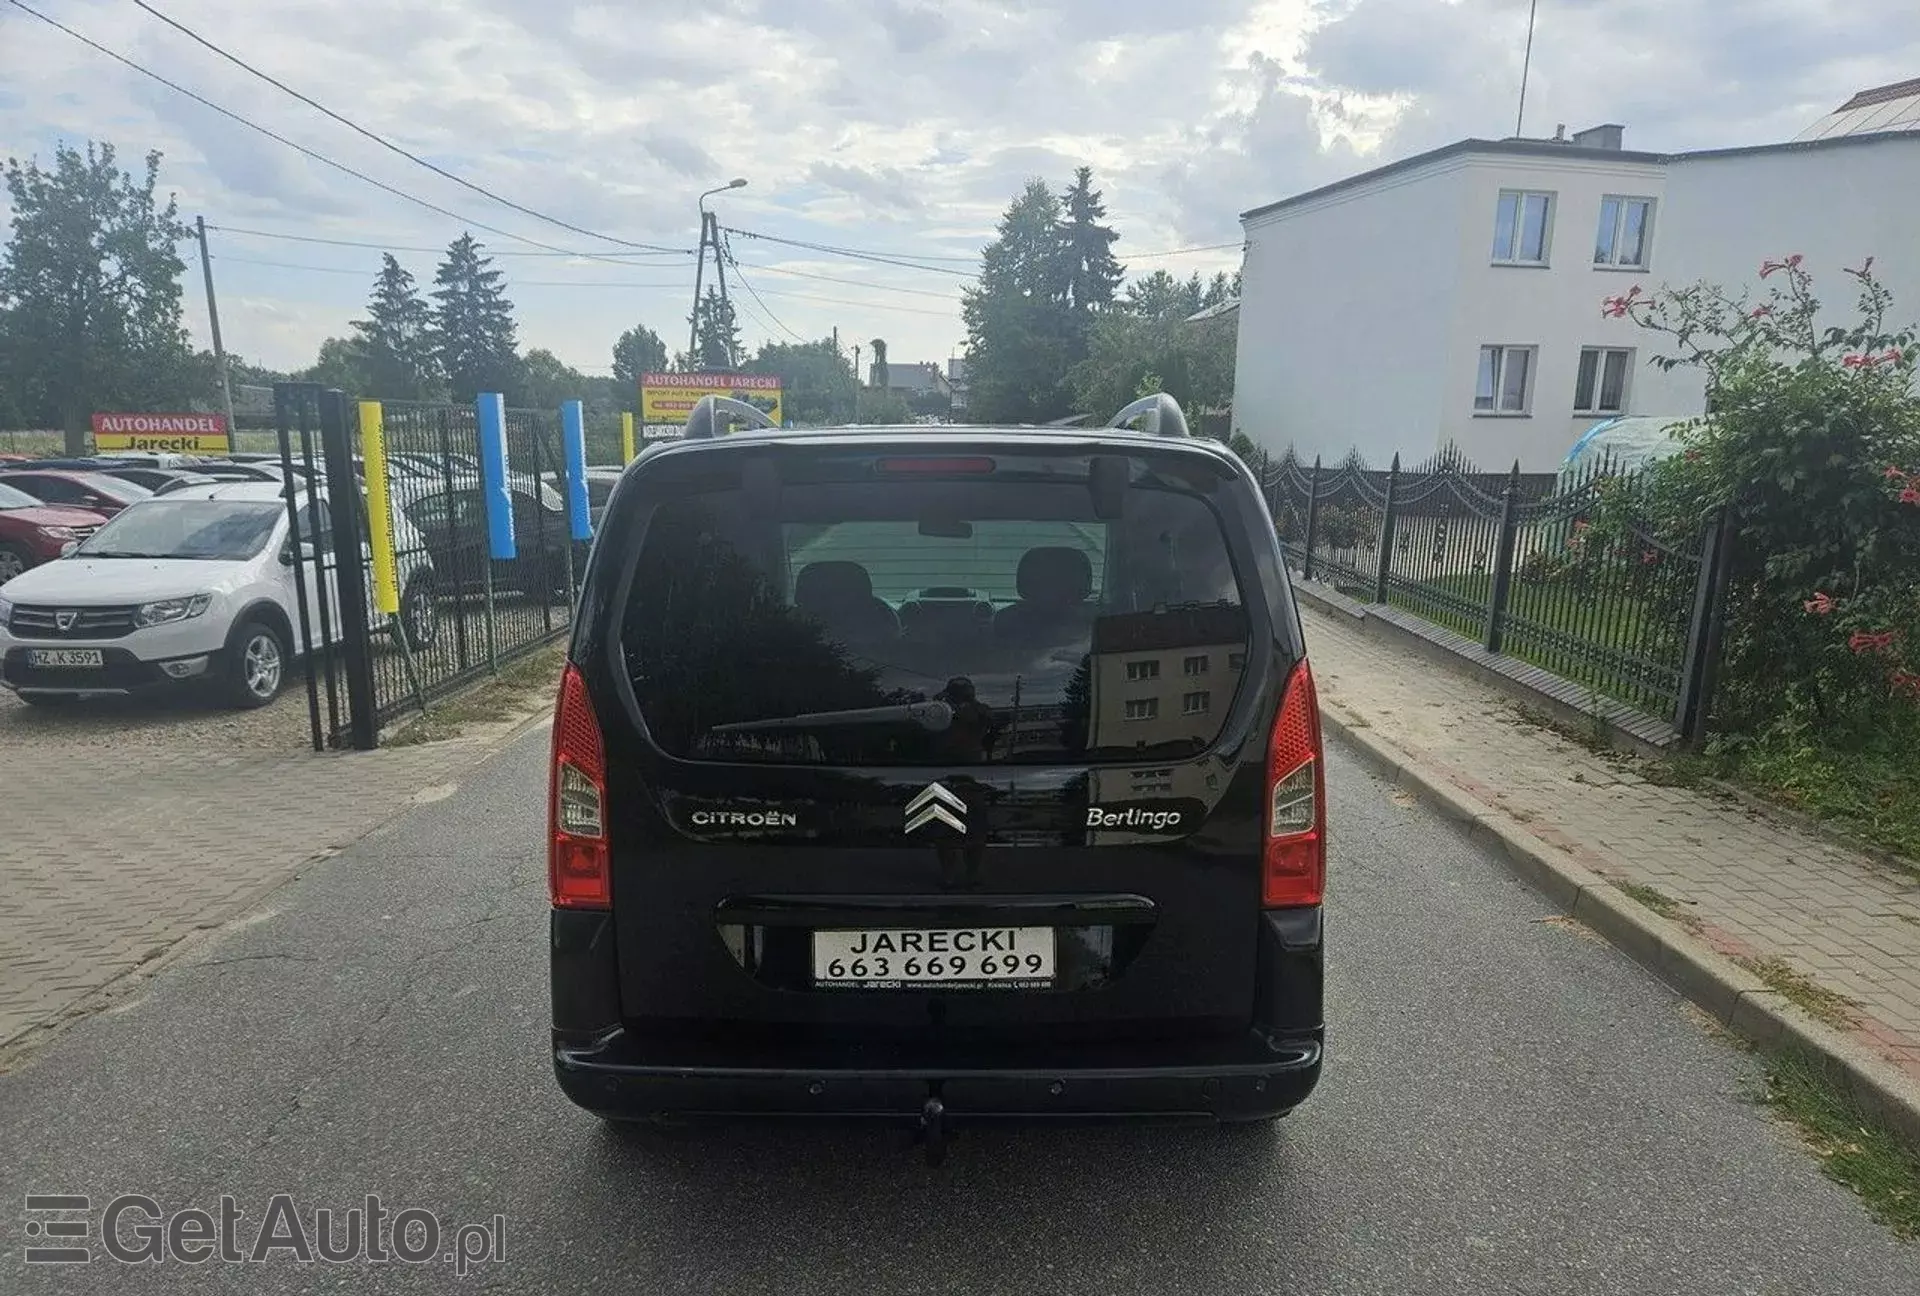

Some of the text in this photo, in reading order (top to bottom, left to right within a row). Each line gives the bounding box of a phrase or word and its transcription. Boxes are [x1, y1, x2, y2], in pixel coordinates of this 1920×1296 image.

[646, 375, 777, 388] AUTOHANDEL JARECKI
[101, 418, 219, 431] AUTOHANDEL
[126, 437, 199, 450] Jarecki
[33, 651, 100, 665] HZ K 3591
[1086, 808, 1181, 829] Berlingo
[850, 930, 1016, 954] JARECKI
[828, 954, 1042, 978] 663 669 699
[863, 981, 901, 989] Jarecki
